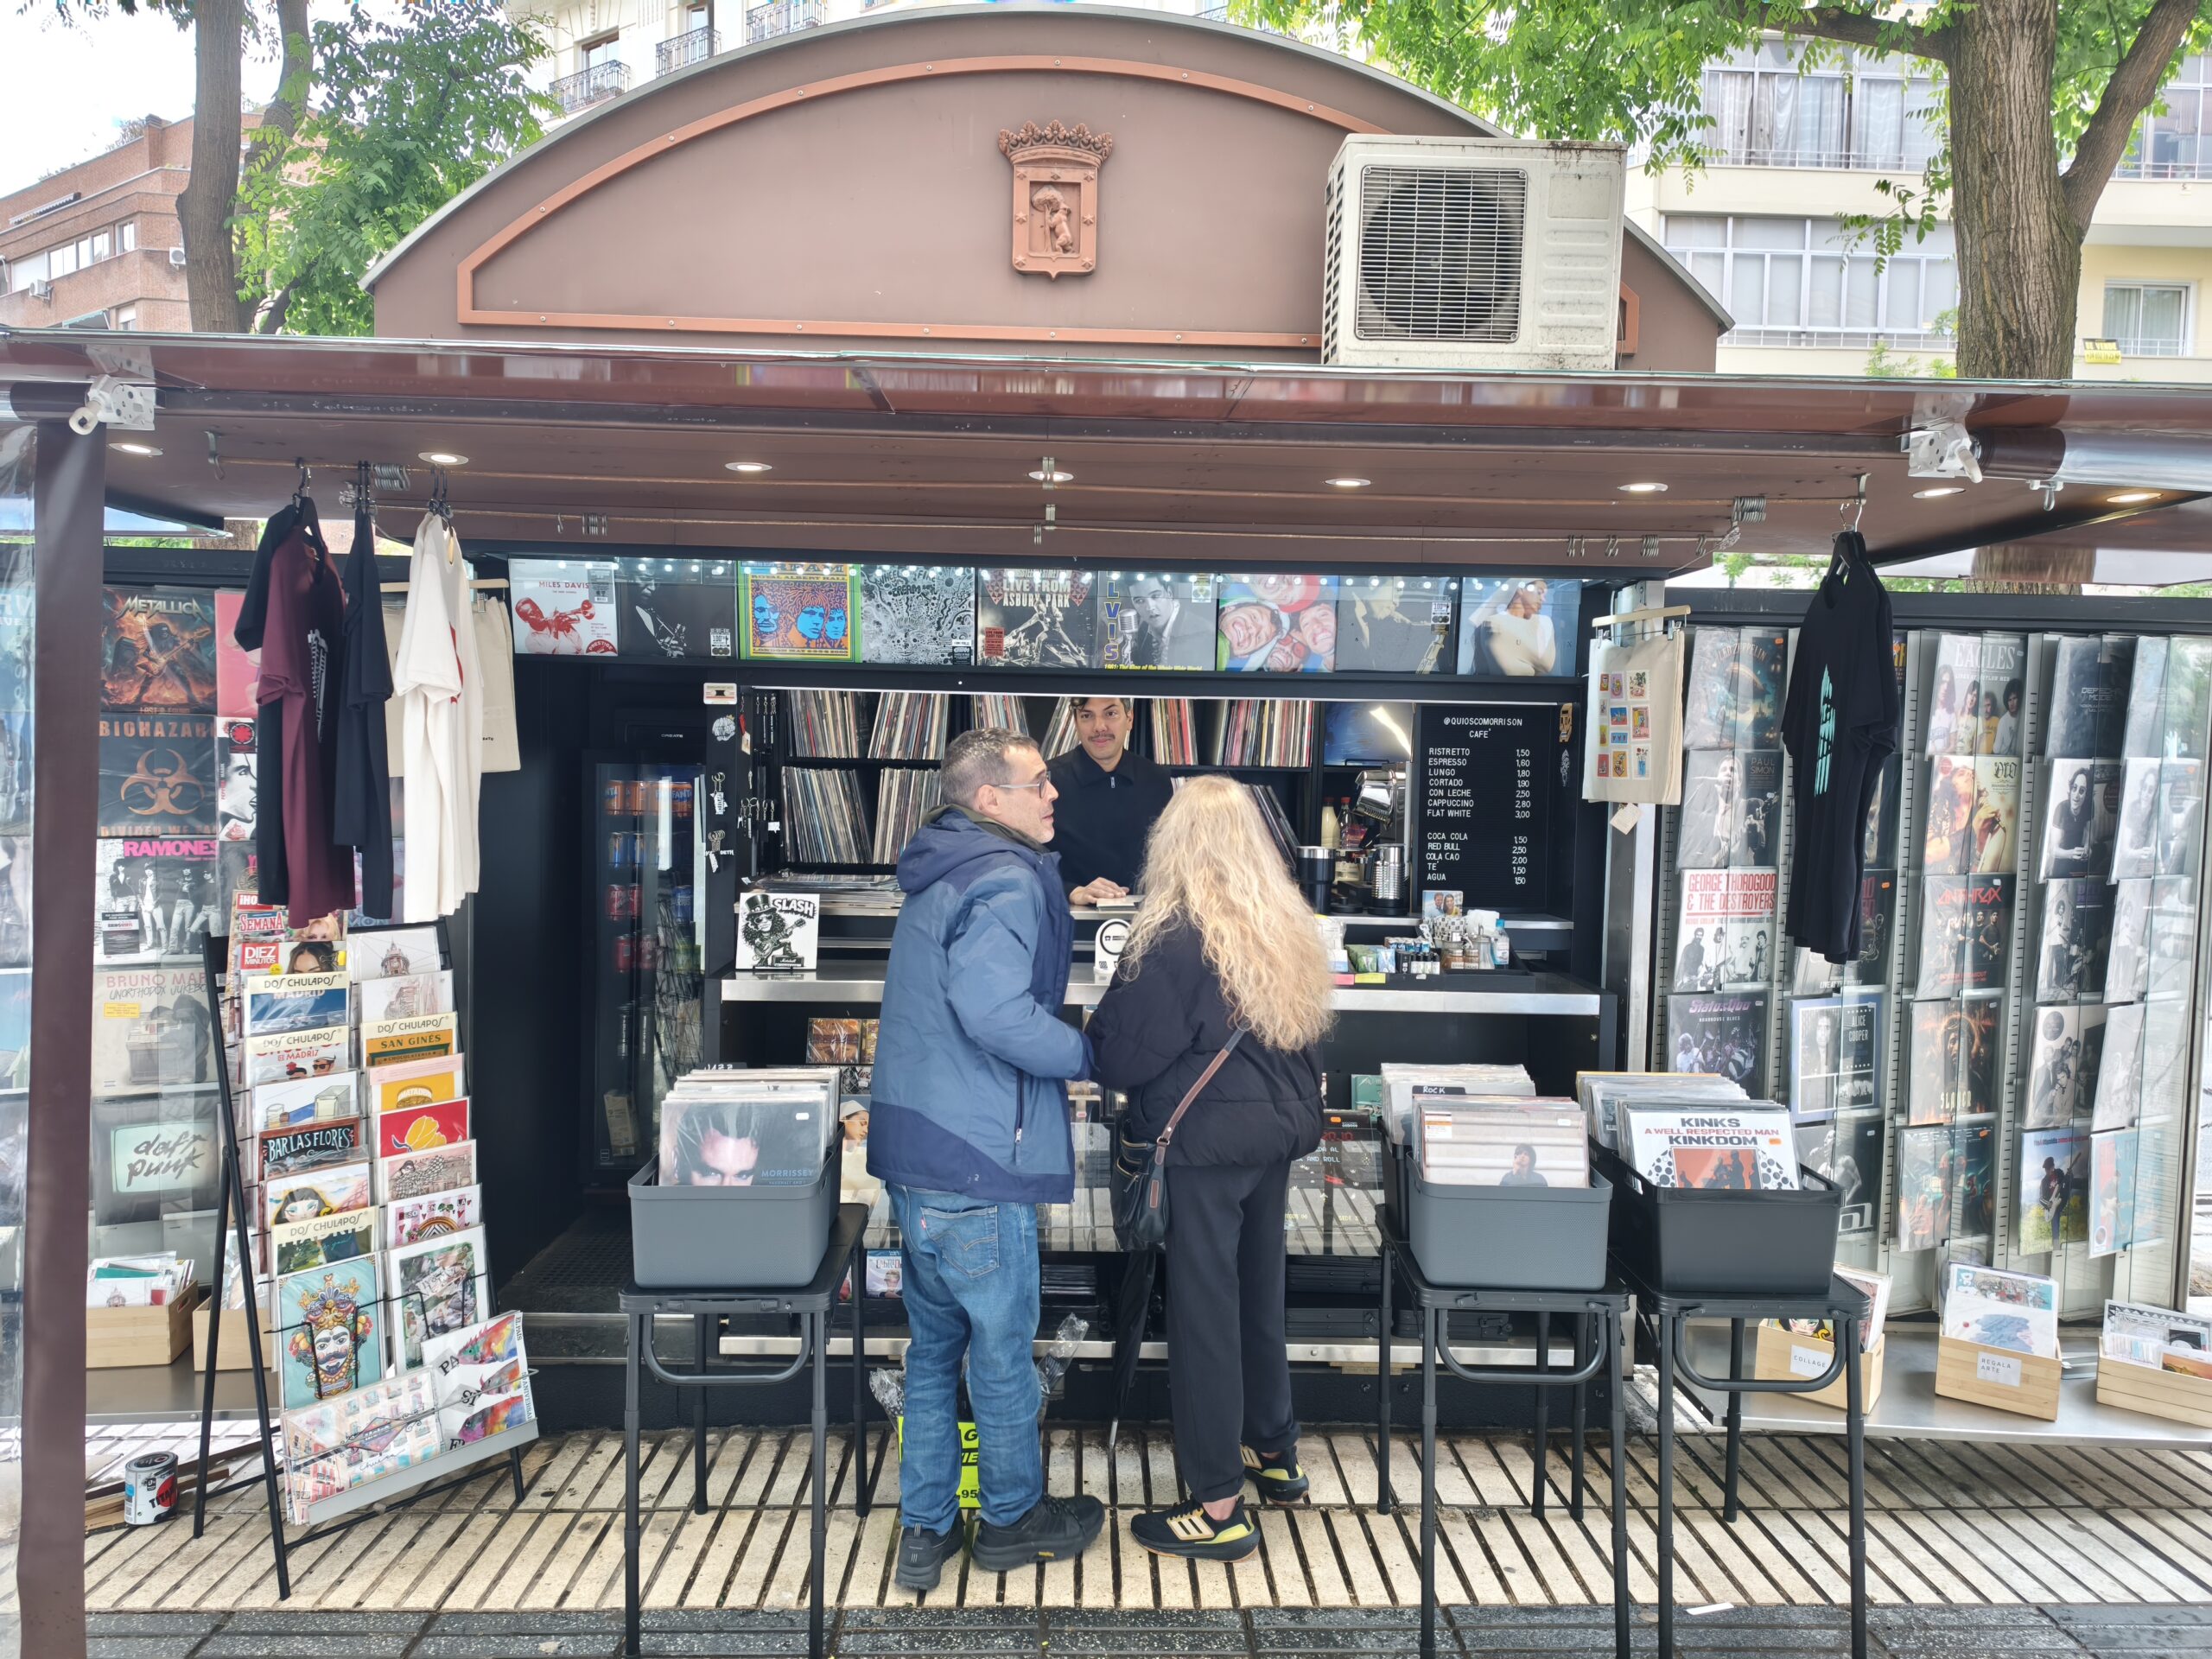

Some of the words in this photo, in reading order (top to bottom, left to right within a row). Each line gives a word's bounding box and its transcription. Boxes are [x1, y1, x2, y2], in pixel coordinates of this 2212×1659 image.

[1002, 580, 1030, 592] LIVE
[1033, 580, 1071, 593] FROM
[1002, 593, 1041, 607] ASBURY
[1046, 594, 1071, 608] PARK
[116, 594, 209, 622] METALLICA
[1955, 643, 2016, 670] EAGLES
[1443, 716, 1522, 727] @QUIOSCOMORRISON
[1428, 747, 1470, 756] RISTRETTO
[1516, 748, 1530, 757] 1,50
[1428, 758, 1467, 766] ESPRESSO
[1516, 759, 1530, 767] 1,60
[1428, 768, 1455, 777] LUNGO
[1516, 769, 1530, 778] 1,80
[1428, 779, 1464, 787] CORTADO
[1516, 779, 1530, 788] 1,90
[1447, 789, 1471, 798] LECHE
[1516, 790, 1530, 798] 2,50
[1427, 799, 1474, 808] CAPPUCCINO
[1515, 800, 1531, 809] 2,80
[1427, 809, 1445, 817] FLAT
[1515, 810, 1530, 819] 3,00
[1450, 832, 1468, 841] COLA
[1514, 836, 1528, 844] 1,50
[1444, 842, 1460, 851] BULL
[1512, 846, 1527, 855] 2,50
[1426, 852, 1443, 861] COLA
[1445, 852, 1460, 861] CAO
[1512, 856, 1528, 865] 2,00
[1512, 866, 1526, 874] 1,50
[1427, 873, 1446, 881] AGUA
[1514, 876, 1527, 885] 1,50
[1688, 874, 1722, 892] GEORGE
[1725, 873, 1777, 892] THOROGOOD
[1935, 886, 2003, 906] ANTHRAX
[1687, 893, 1694, 911] &
[1699, 893, 1716, 911] THE
[1719, 893, 1776, 911] DESTROYERS
[772, 897, 816, 918] SLASH
[239, 911, 285, 932] SEMANA
[245, 946, 276, 959] DIEZ
[245, 957, 276, 966] MINUTOS
[106, 973, 166, 988] BRUNO
[173, 972, 207, 986] MAR
[288, 976, 337, 986] CHULAPOS
[170, 983, 208, 995] JUKEBO
[398, 1017, 445, 1031] CHULAPOS
[1851, 1015, 1866, 1027] ALICE
[286, 1030, 337, 1045] CHULAPOS
[1848, 1029, 1869, 1042] COOPER
[380, 1039, 404, 1049] SAN
[408, 1033, 442, 1046] GINÉS
[1680, 1117, 1741, 1128] KINKS
[133, 1130, 209, 1158] daft
[267, 1136, 288, 1162] BAR
[289, 1132, 311, 1151] LAS
[313, 1127, 351, 1147] FLORES
[1668, 1135, 1759, 1146] KINKDOM
[126, 1147, 206, 1188] punk
[760, 1169, 814, 1178] MORRISSEY
[289, 1220, 312, 1236] DOS
[313, 1211, 362, 1232] CHULAPOS
[1793, 1354, 1827, 1369] COLLAGE
[1981, 1357, 2012, 1370] REGALA
[1980, 1365, 2001, 1374] ARTE
